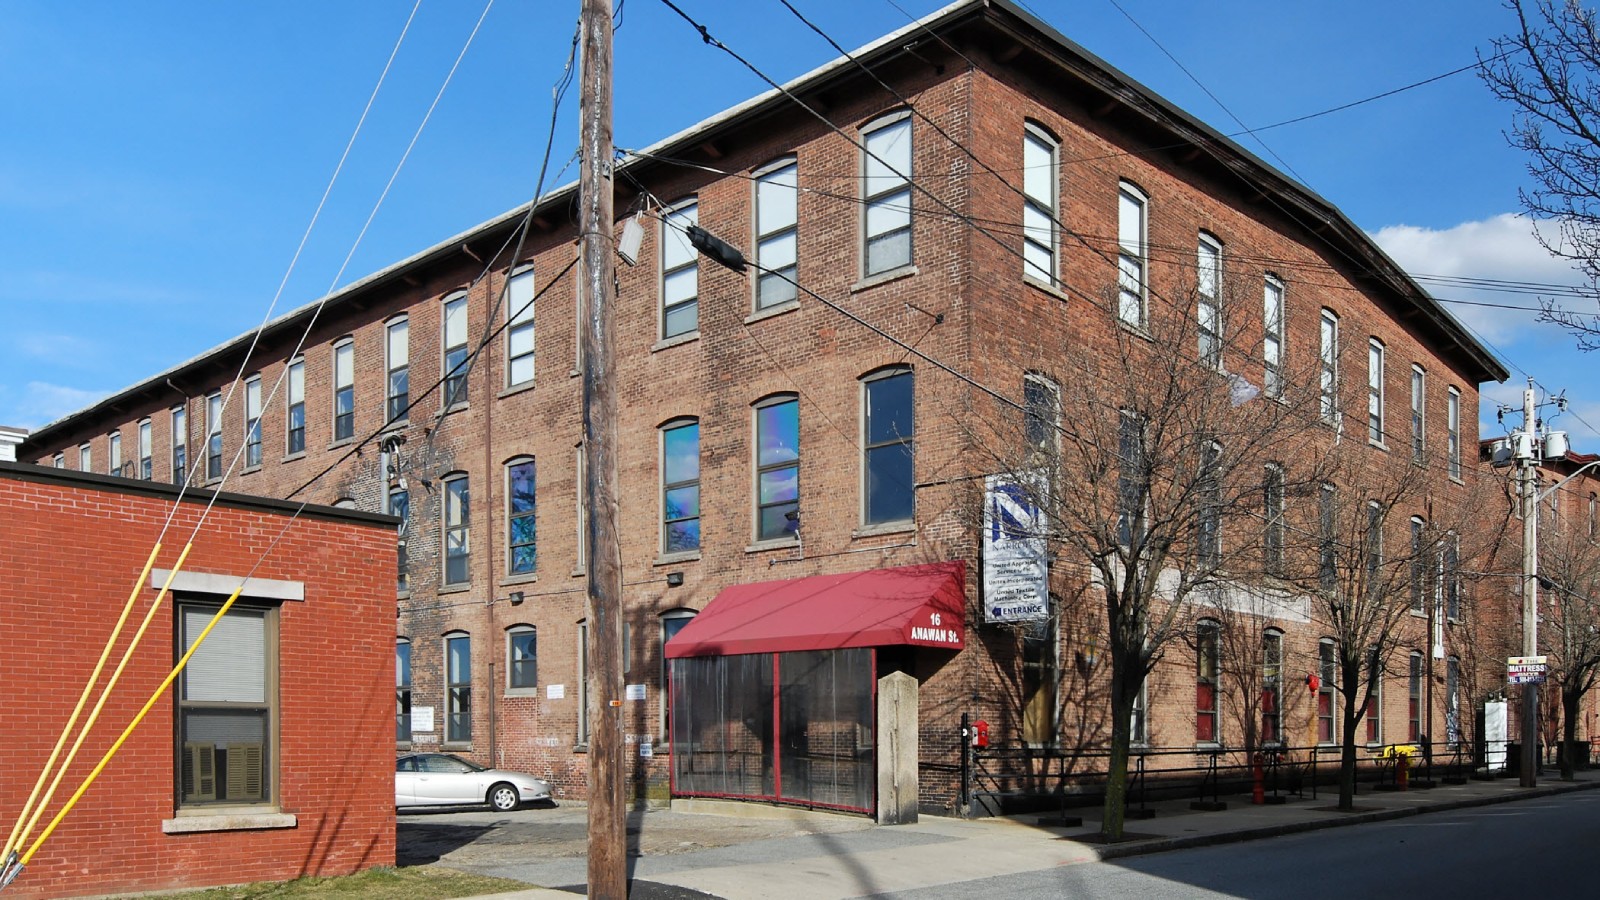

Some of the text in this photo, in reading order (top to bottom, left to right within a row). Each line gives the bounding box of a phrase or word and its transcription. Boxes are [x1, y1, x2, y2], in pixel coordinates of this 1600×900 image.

[1003, 605, 1042, 615] ENTRANCE
[930, 612, 941, 626] 16
[911, 626, 959, 643] ANAWAN St.
[1509, 664, 1545, 673] MATTRESS
